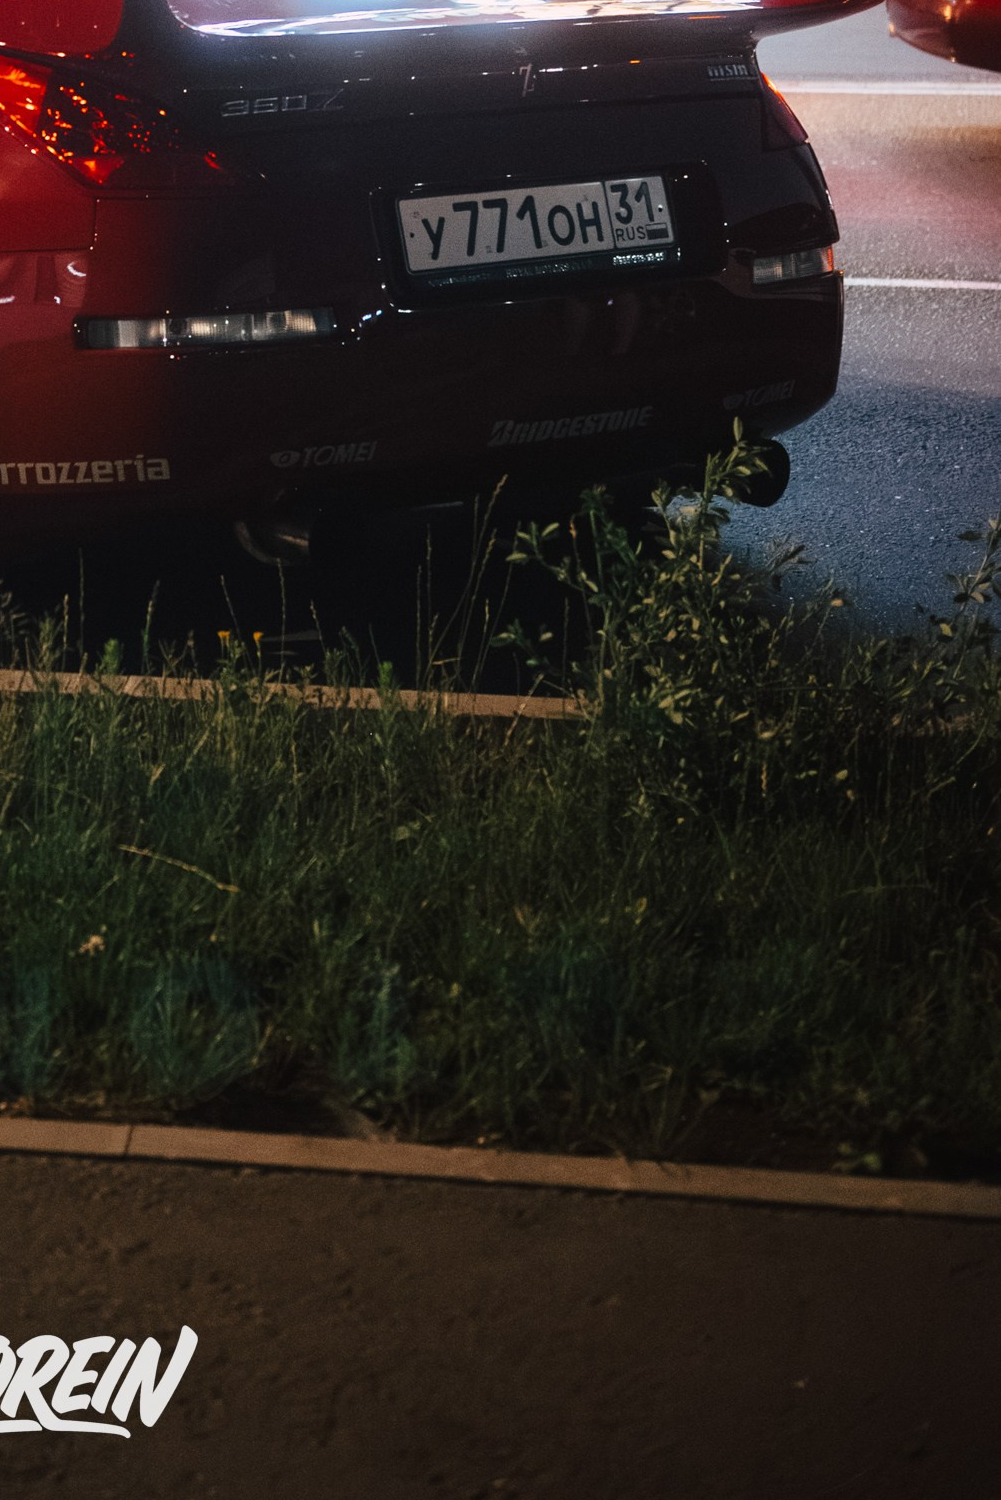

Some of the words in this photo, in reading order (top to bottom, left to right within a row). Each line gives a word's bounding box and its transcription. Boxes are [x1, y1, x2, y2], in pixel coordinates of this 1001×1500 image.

[707, 64, 757, 77] nism
[221, 88, 344, 117] 350Z
[610, 182, 655, 225] 31
[616, 226, 646, 242] RUS
[487, 405, 655, 448] BRIDGESTONE
[302, 440, 378, 467] TOMEI
